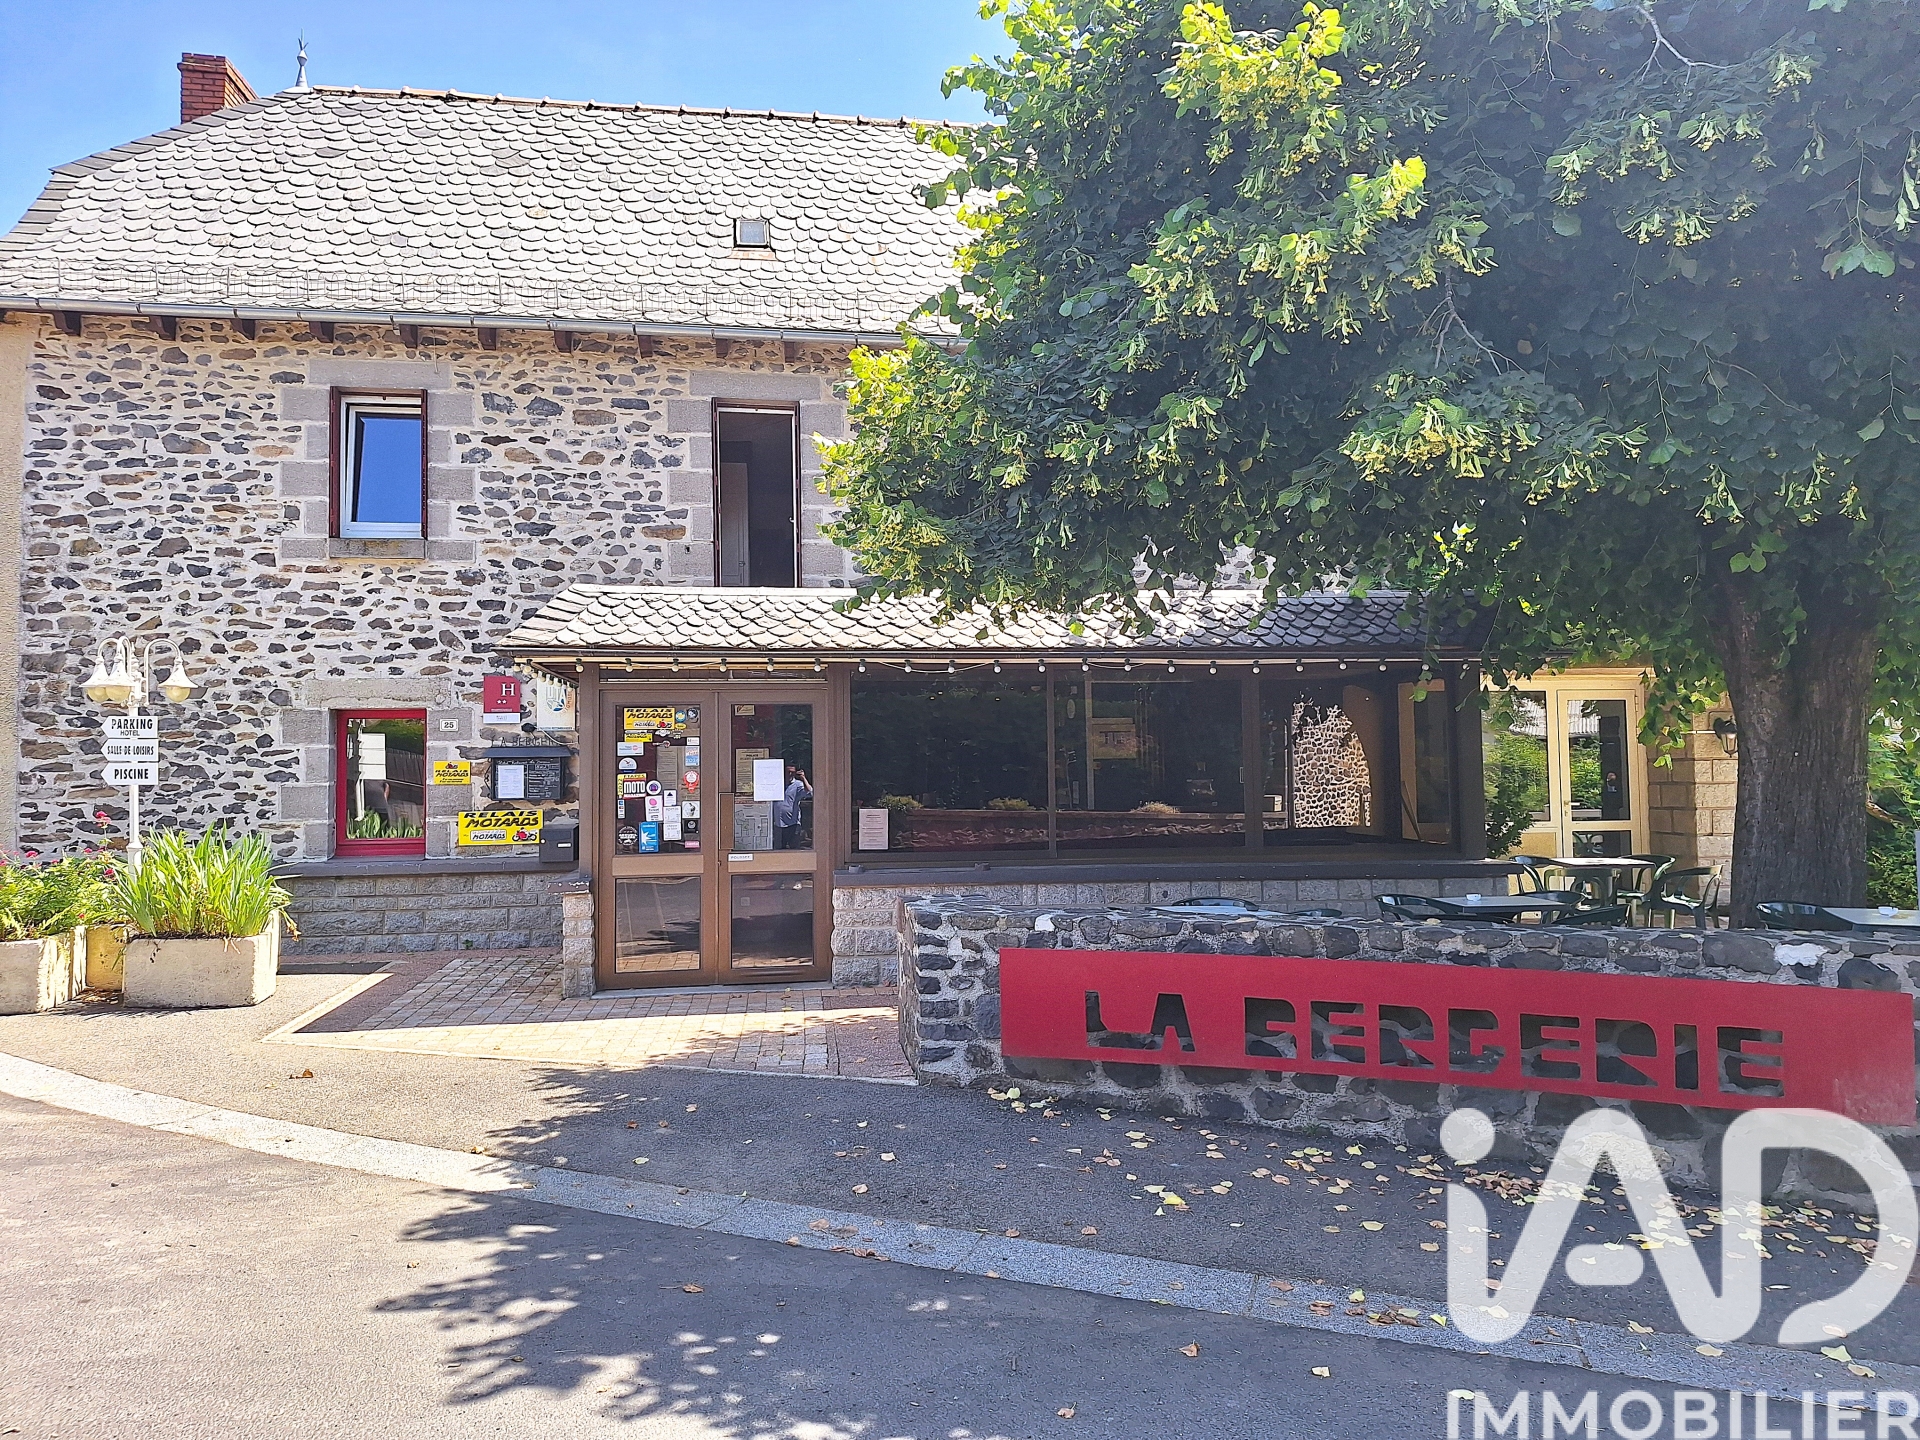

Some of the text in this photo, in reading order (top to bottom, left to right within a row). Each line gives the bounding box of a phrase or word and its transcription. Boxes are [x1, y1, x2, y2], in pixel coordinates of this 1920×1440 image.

[501, 683, 515, 696] H
[111, 719, 153, 730] PARKING
[107, 746, 154, 755] SALLE DE LOISIRS
[114, 769, 149, 780] PISCINE
[623, 781, 646, 794] MOTO
[465, 817, 539, 828] MOTARDS
[1085, 990, 1785, 1098] LA BERGERIE
